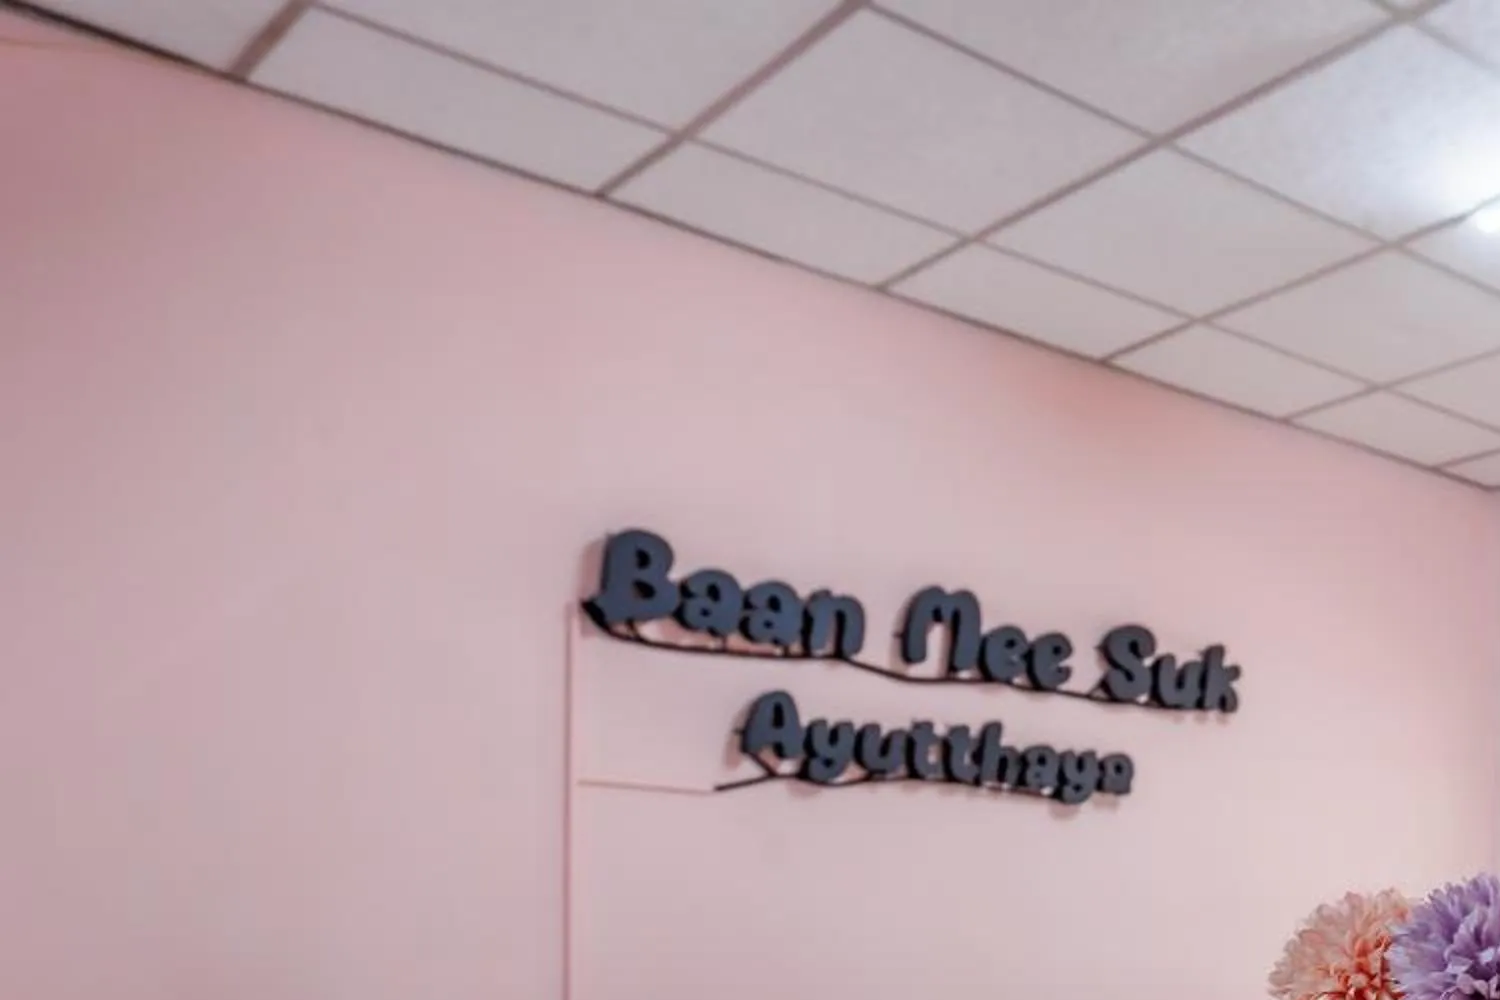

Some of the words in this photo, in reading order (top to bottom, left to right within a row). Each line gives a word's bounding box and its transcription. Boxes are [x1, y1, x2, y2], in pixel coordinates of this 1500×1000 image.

[596, 529, 865, 657] Baan
[902, 586, 1073, 691] Mee
[1101, 625, 1241, 713] Suk
[741, 690, 1134, 804] Ayutthaya
